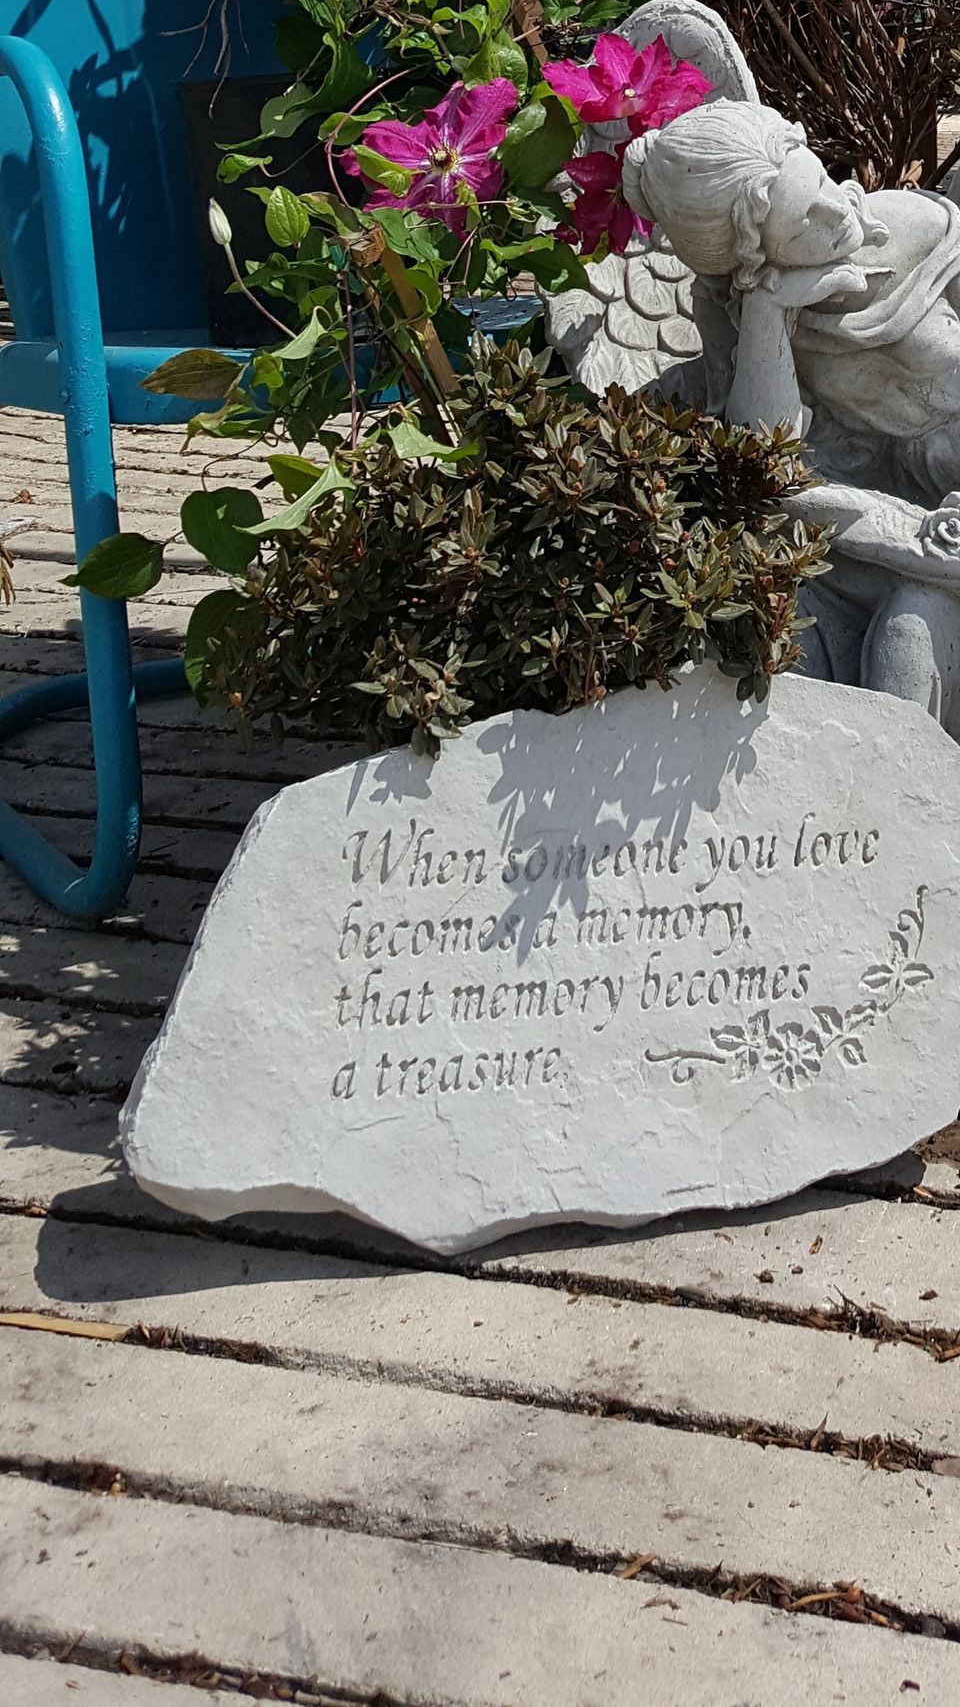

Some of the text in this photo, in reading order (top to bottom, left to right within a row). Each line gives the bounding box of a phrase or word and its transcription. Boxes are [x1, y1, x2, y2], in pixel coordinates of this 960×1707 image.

[341, 811, 880, 894] When someone you love
[338, 899, 523, 961] becomes
[532, 910, 559, 950] a
[334, 949, 811, 1033] that memory becomes
[331, 1060, 358, 1100] a
